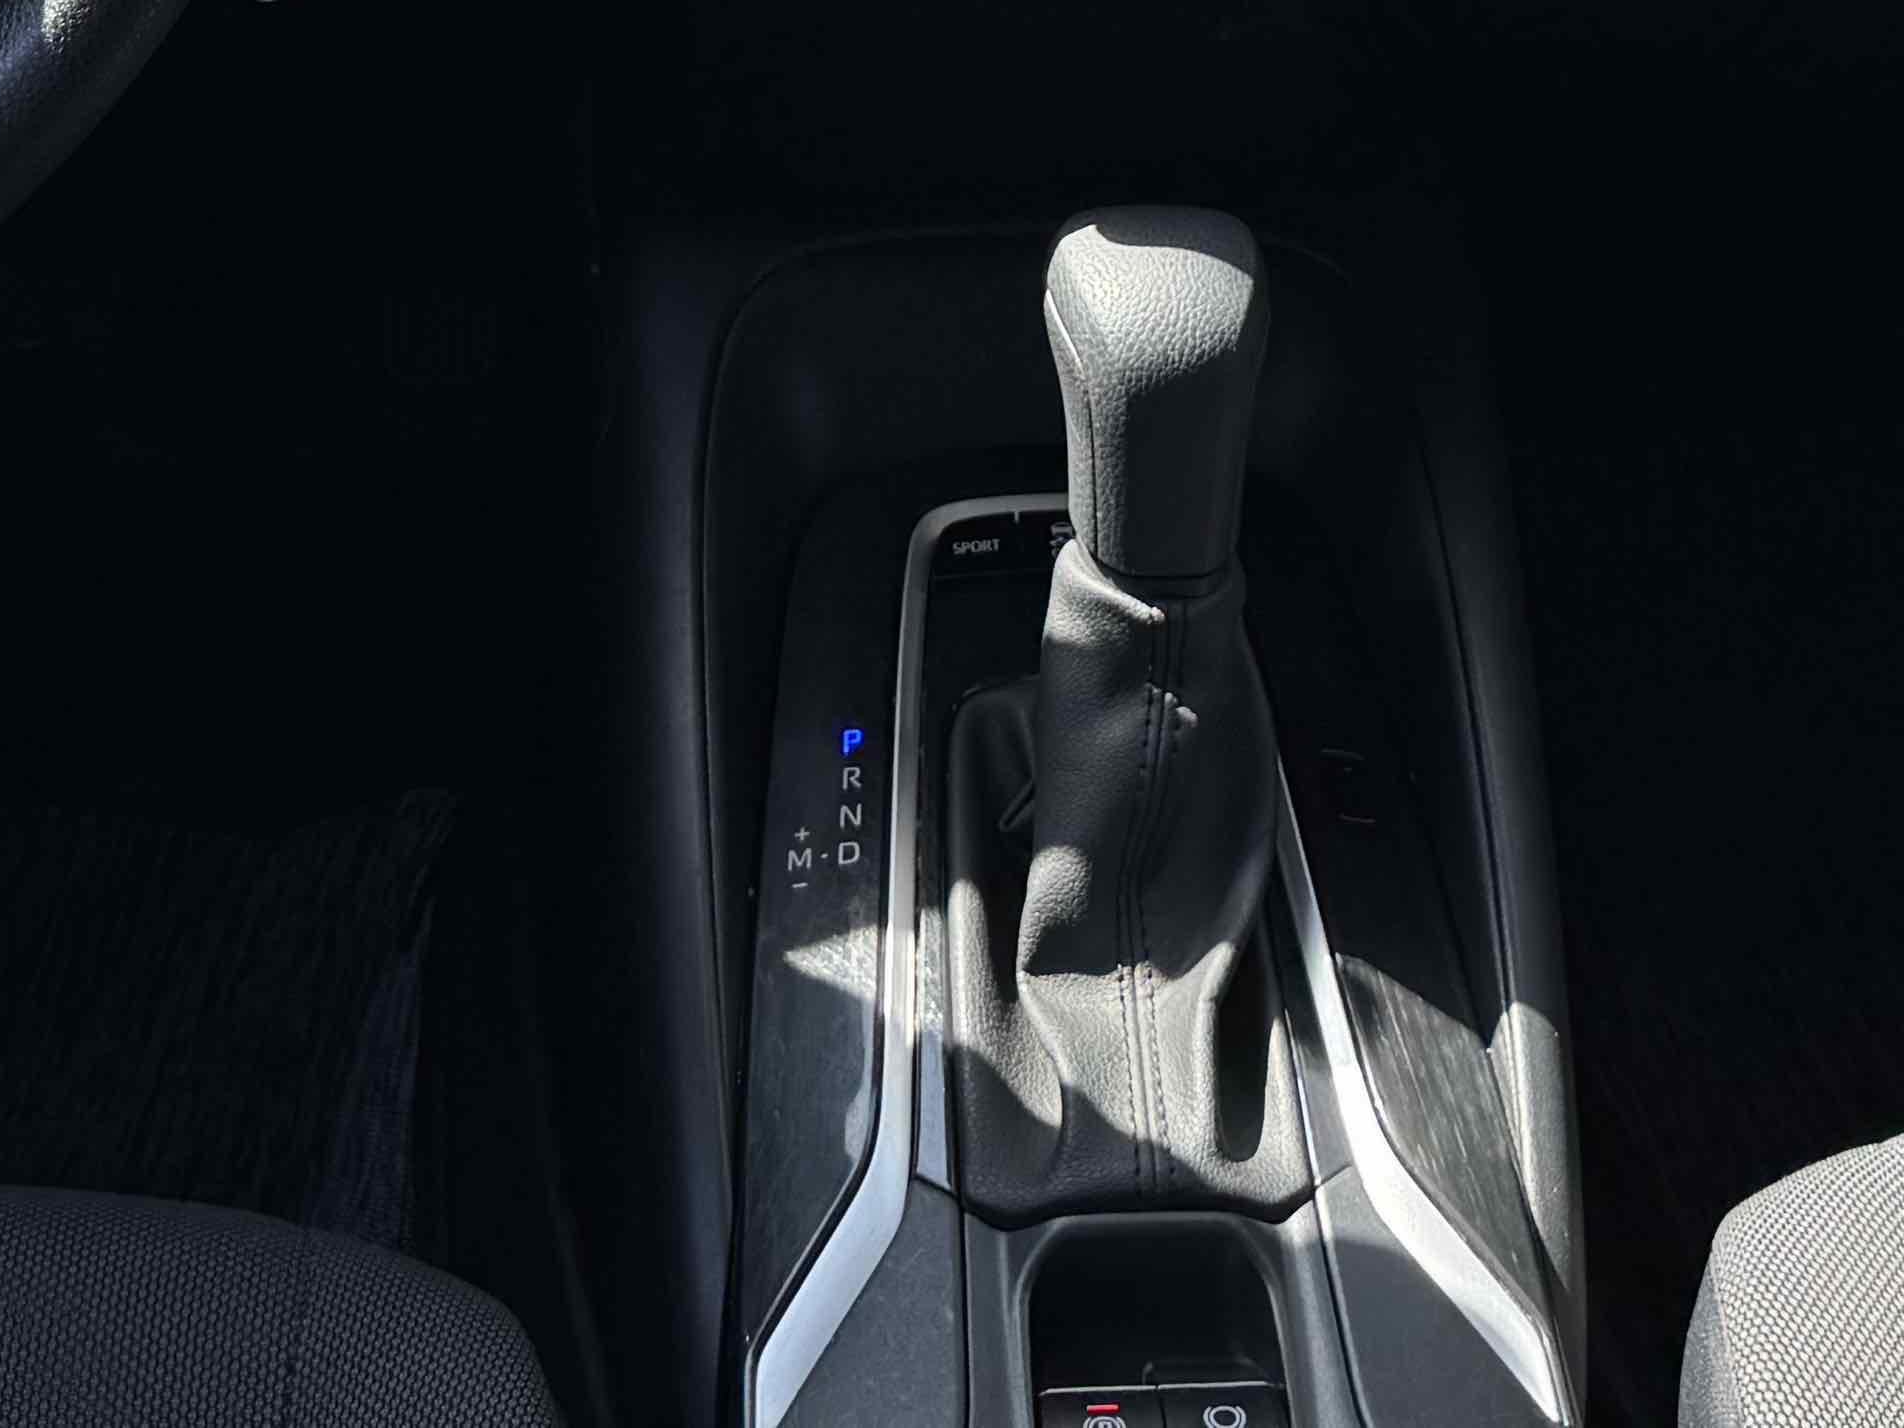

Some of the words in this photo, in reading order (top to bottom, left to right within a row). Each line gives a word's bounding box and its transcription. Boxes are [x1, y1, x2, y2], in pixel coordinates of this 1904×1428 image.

[953, 537, 1001, 556] SPORT
[842, 727, 864, 756] P
[842, 766, 862, 791] R
[839, 803, 862, 829] N
[788, 847, 813, 872] M
[837, 841, 861, 865] D
